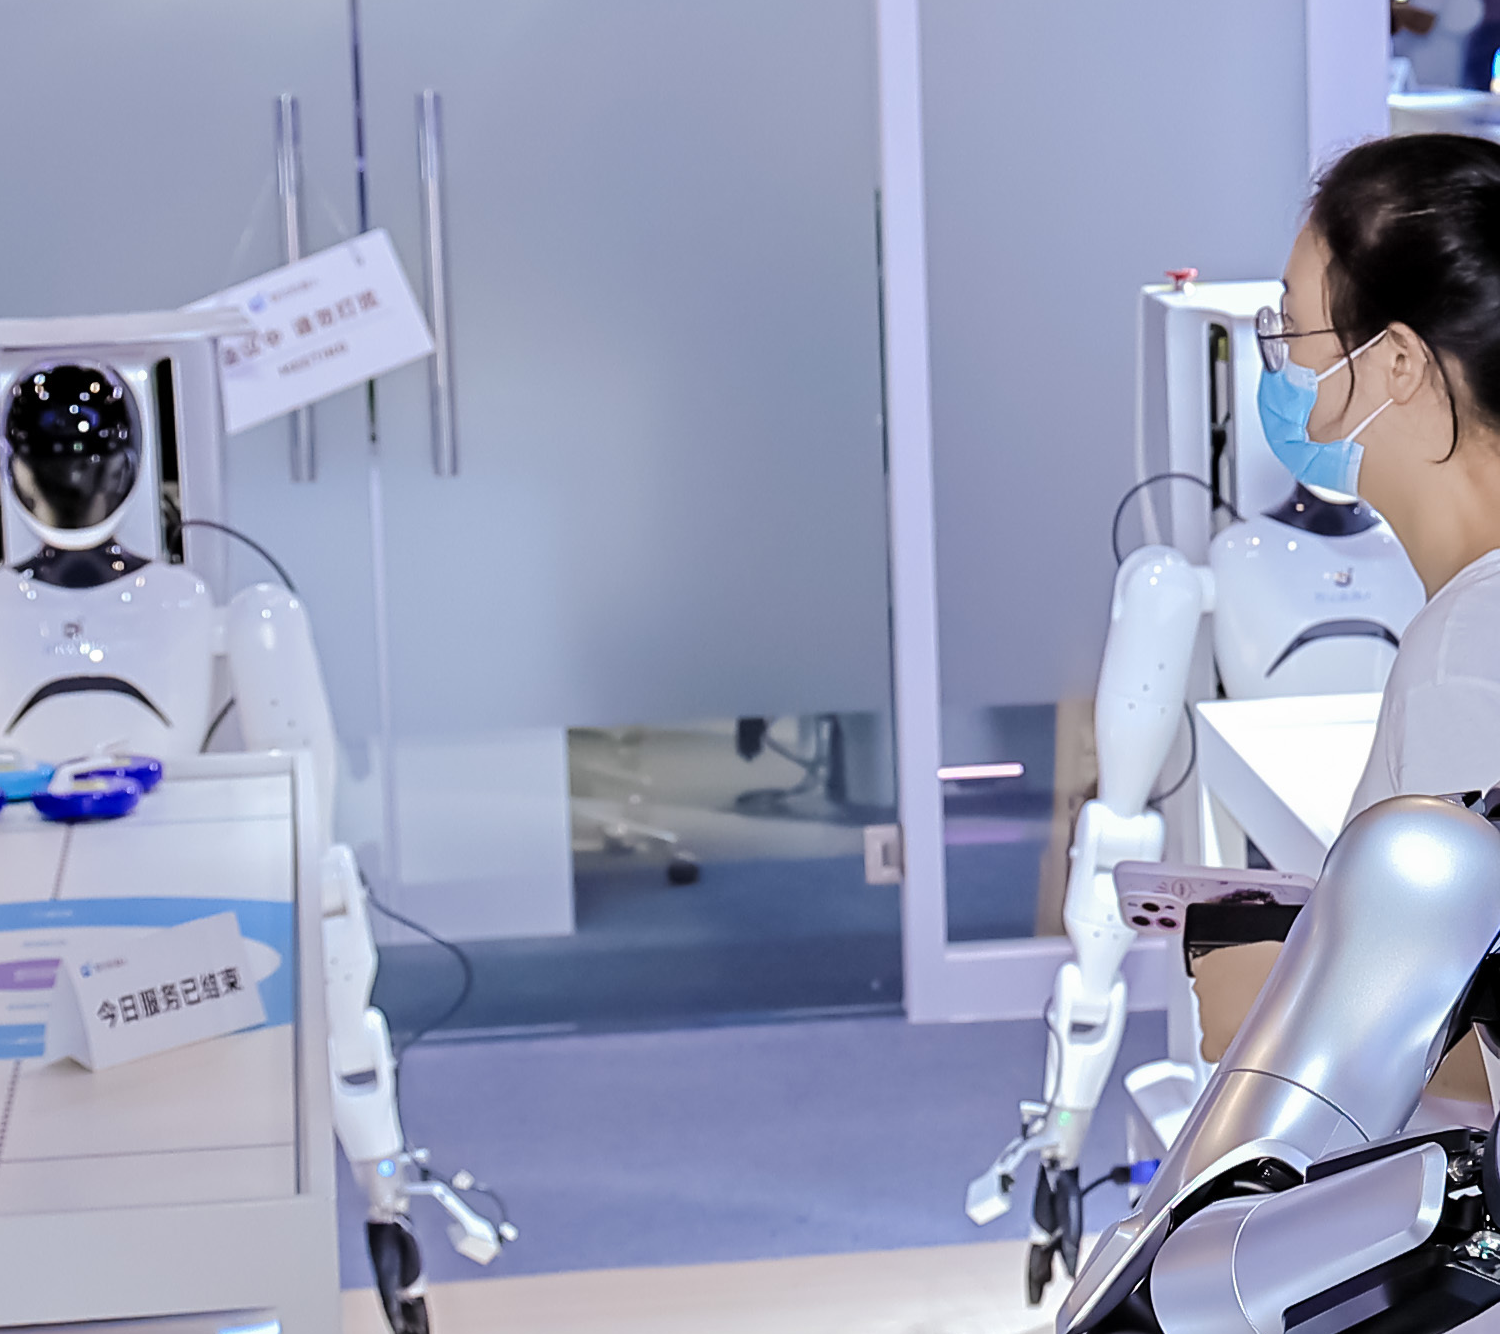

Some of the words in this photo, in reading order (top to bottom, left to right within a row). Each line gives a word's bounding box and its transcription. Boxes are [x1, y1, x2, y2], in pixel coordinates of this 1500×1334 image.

[97, 966, 244, 1028] 今日服务已结束
